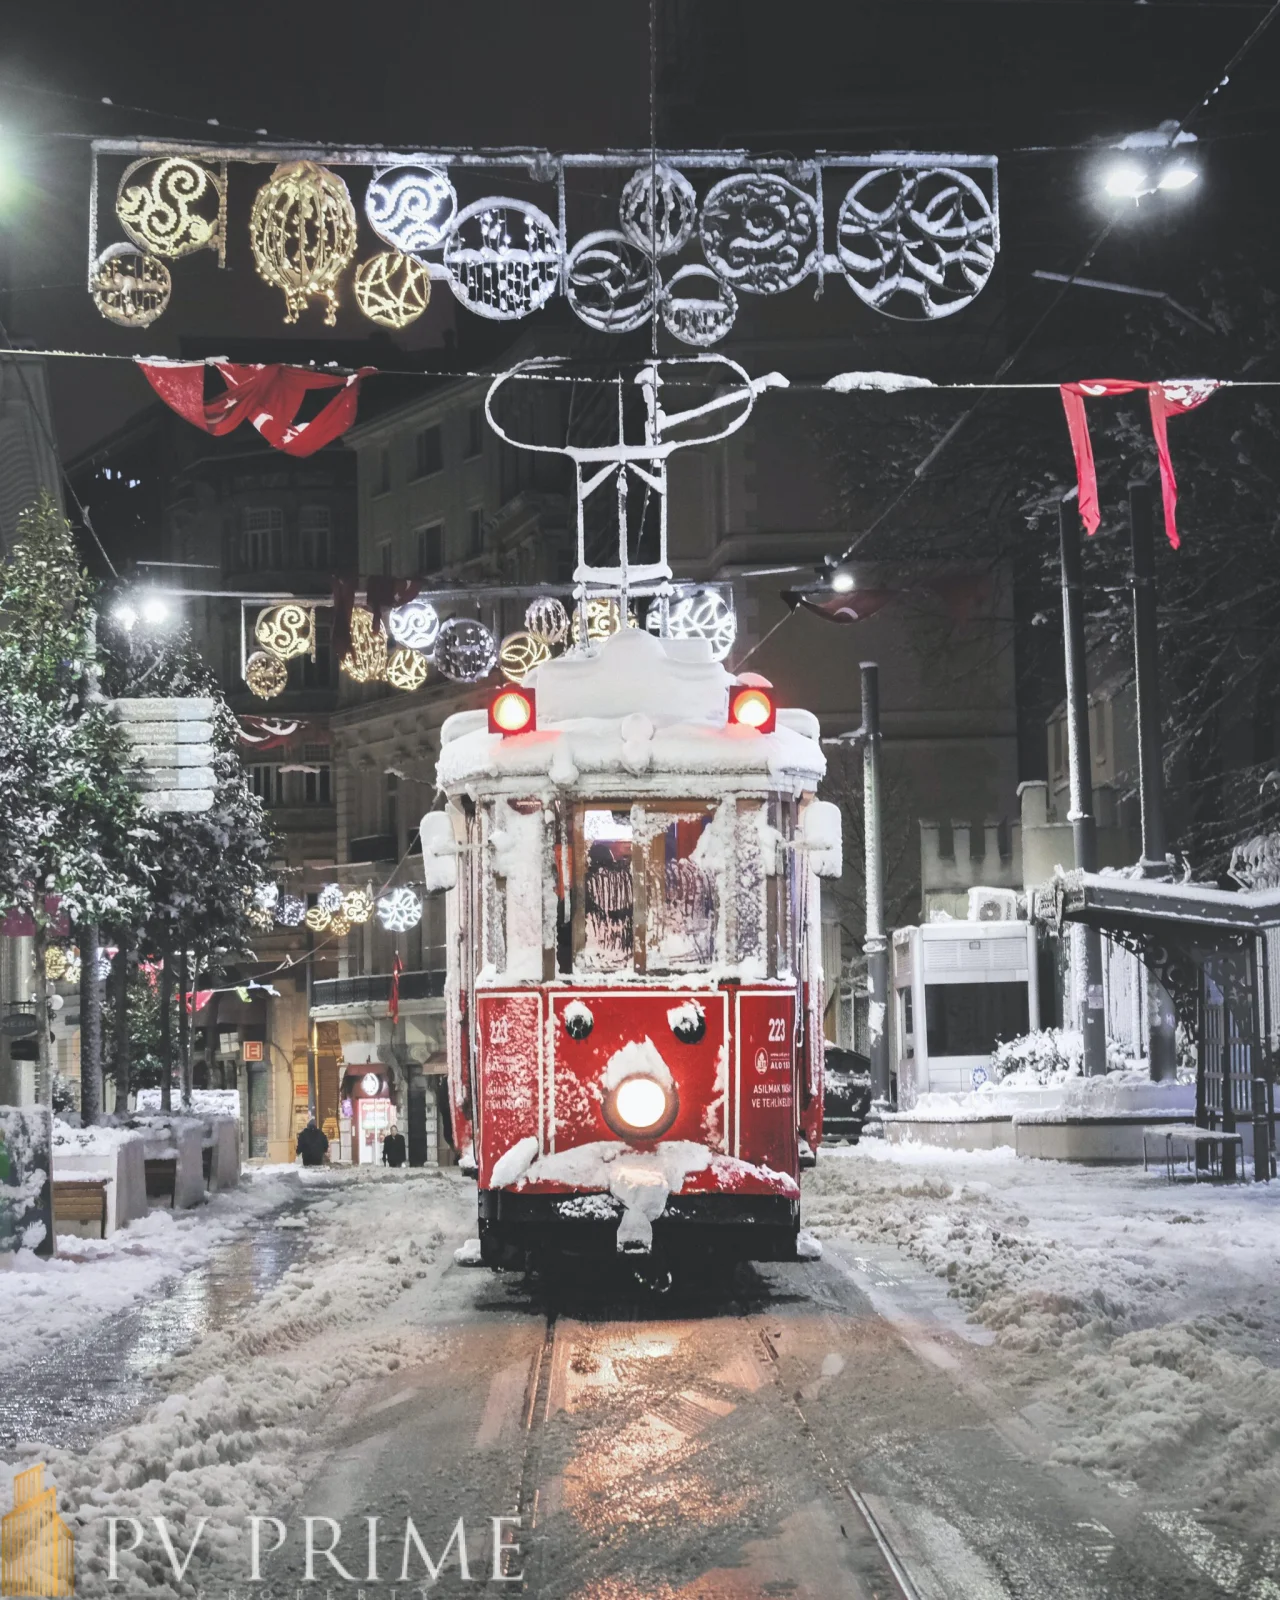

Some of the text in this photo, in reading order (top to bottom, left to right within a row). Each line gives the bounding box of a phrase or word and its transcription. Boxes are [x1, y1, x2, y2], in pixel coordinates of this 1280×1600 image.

[768, 1018, 786, 1042] 223
[753, 1083, 781, 1094] ASILMAK
[751, 1098, 761, 1109] VE
